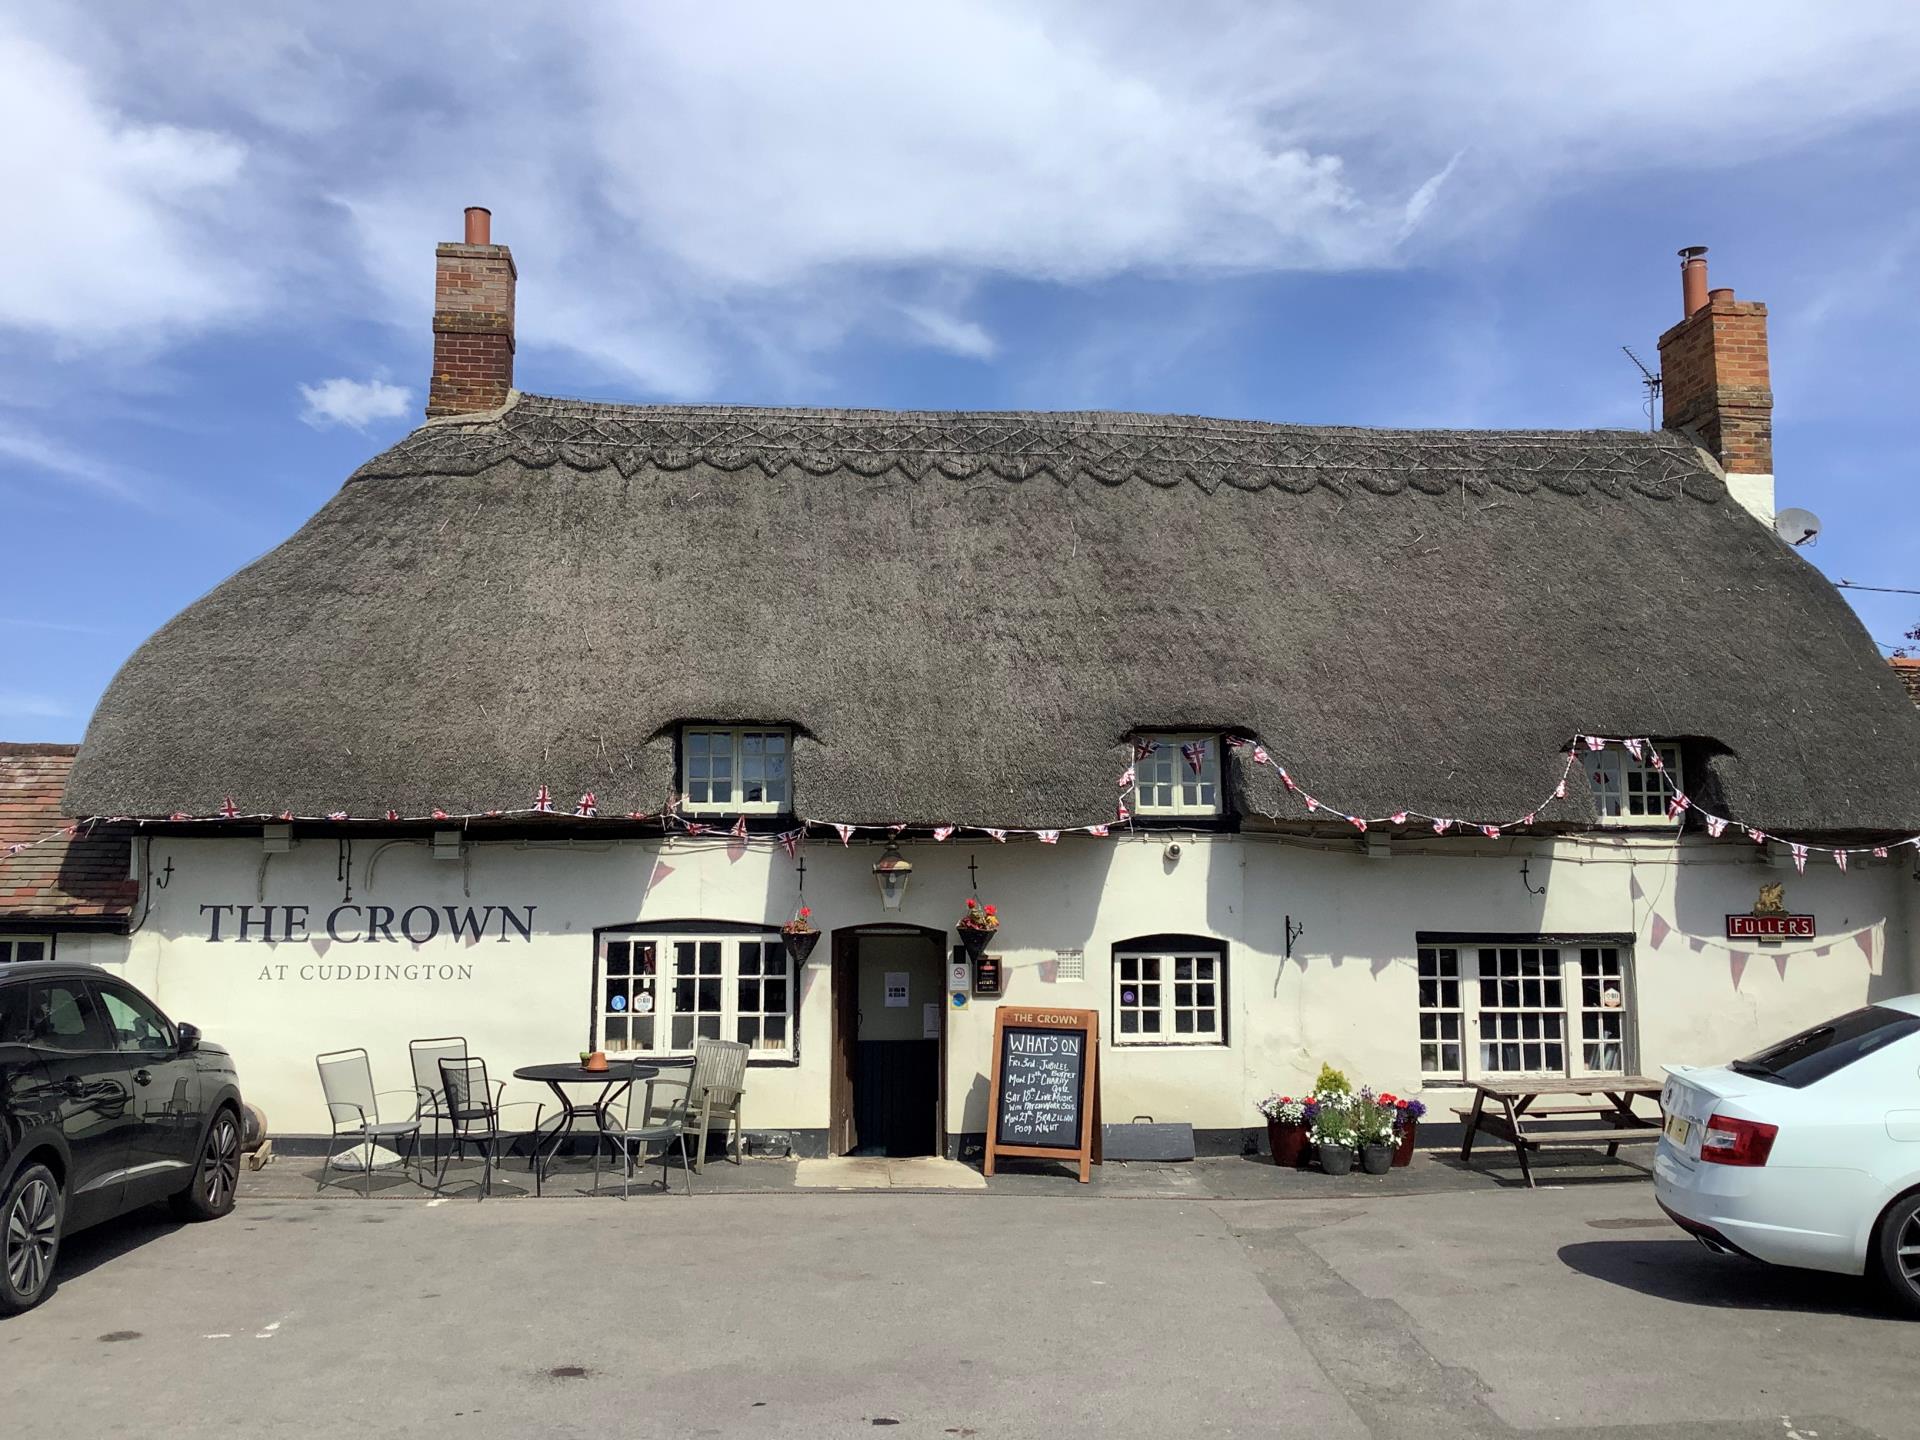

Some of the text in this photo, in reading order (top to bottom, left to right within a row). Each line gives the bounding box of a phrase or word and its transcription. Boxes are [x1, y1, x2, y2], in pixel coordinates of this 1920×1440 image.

[200, 904, 538, 944] THE CROWN
[1734, 918, 1810, 936] FULLER'S
[257, 964, 474, 981] AT CUDDINGTON
[1014, 1013, 1078, 1025] THE CROWN
[1009, 1033, 1079, 1053] WHAT'S ON
